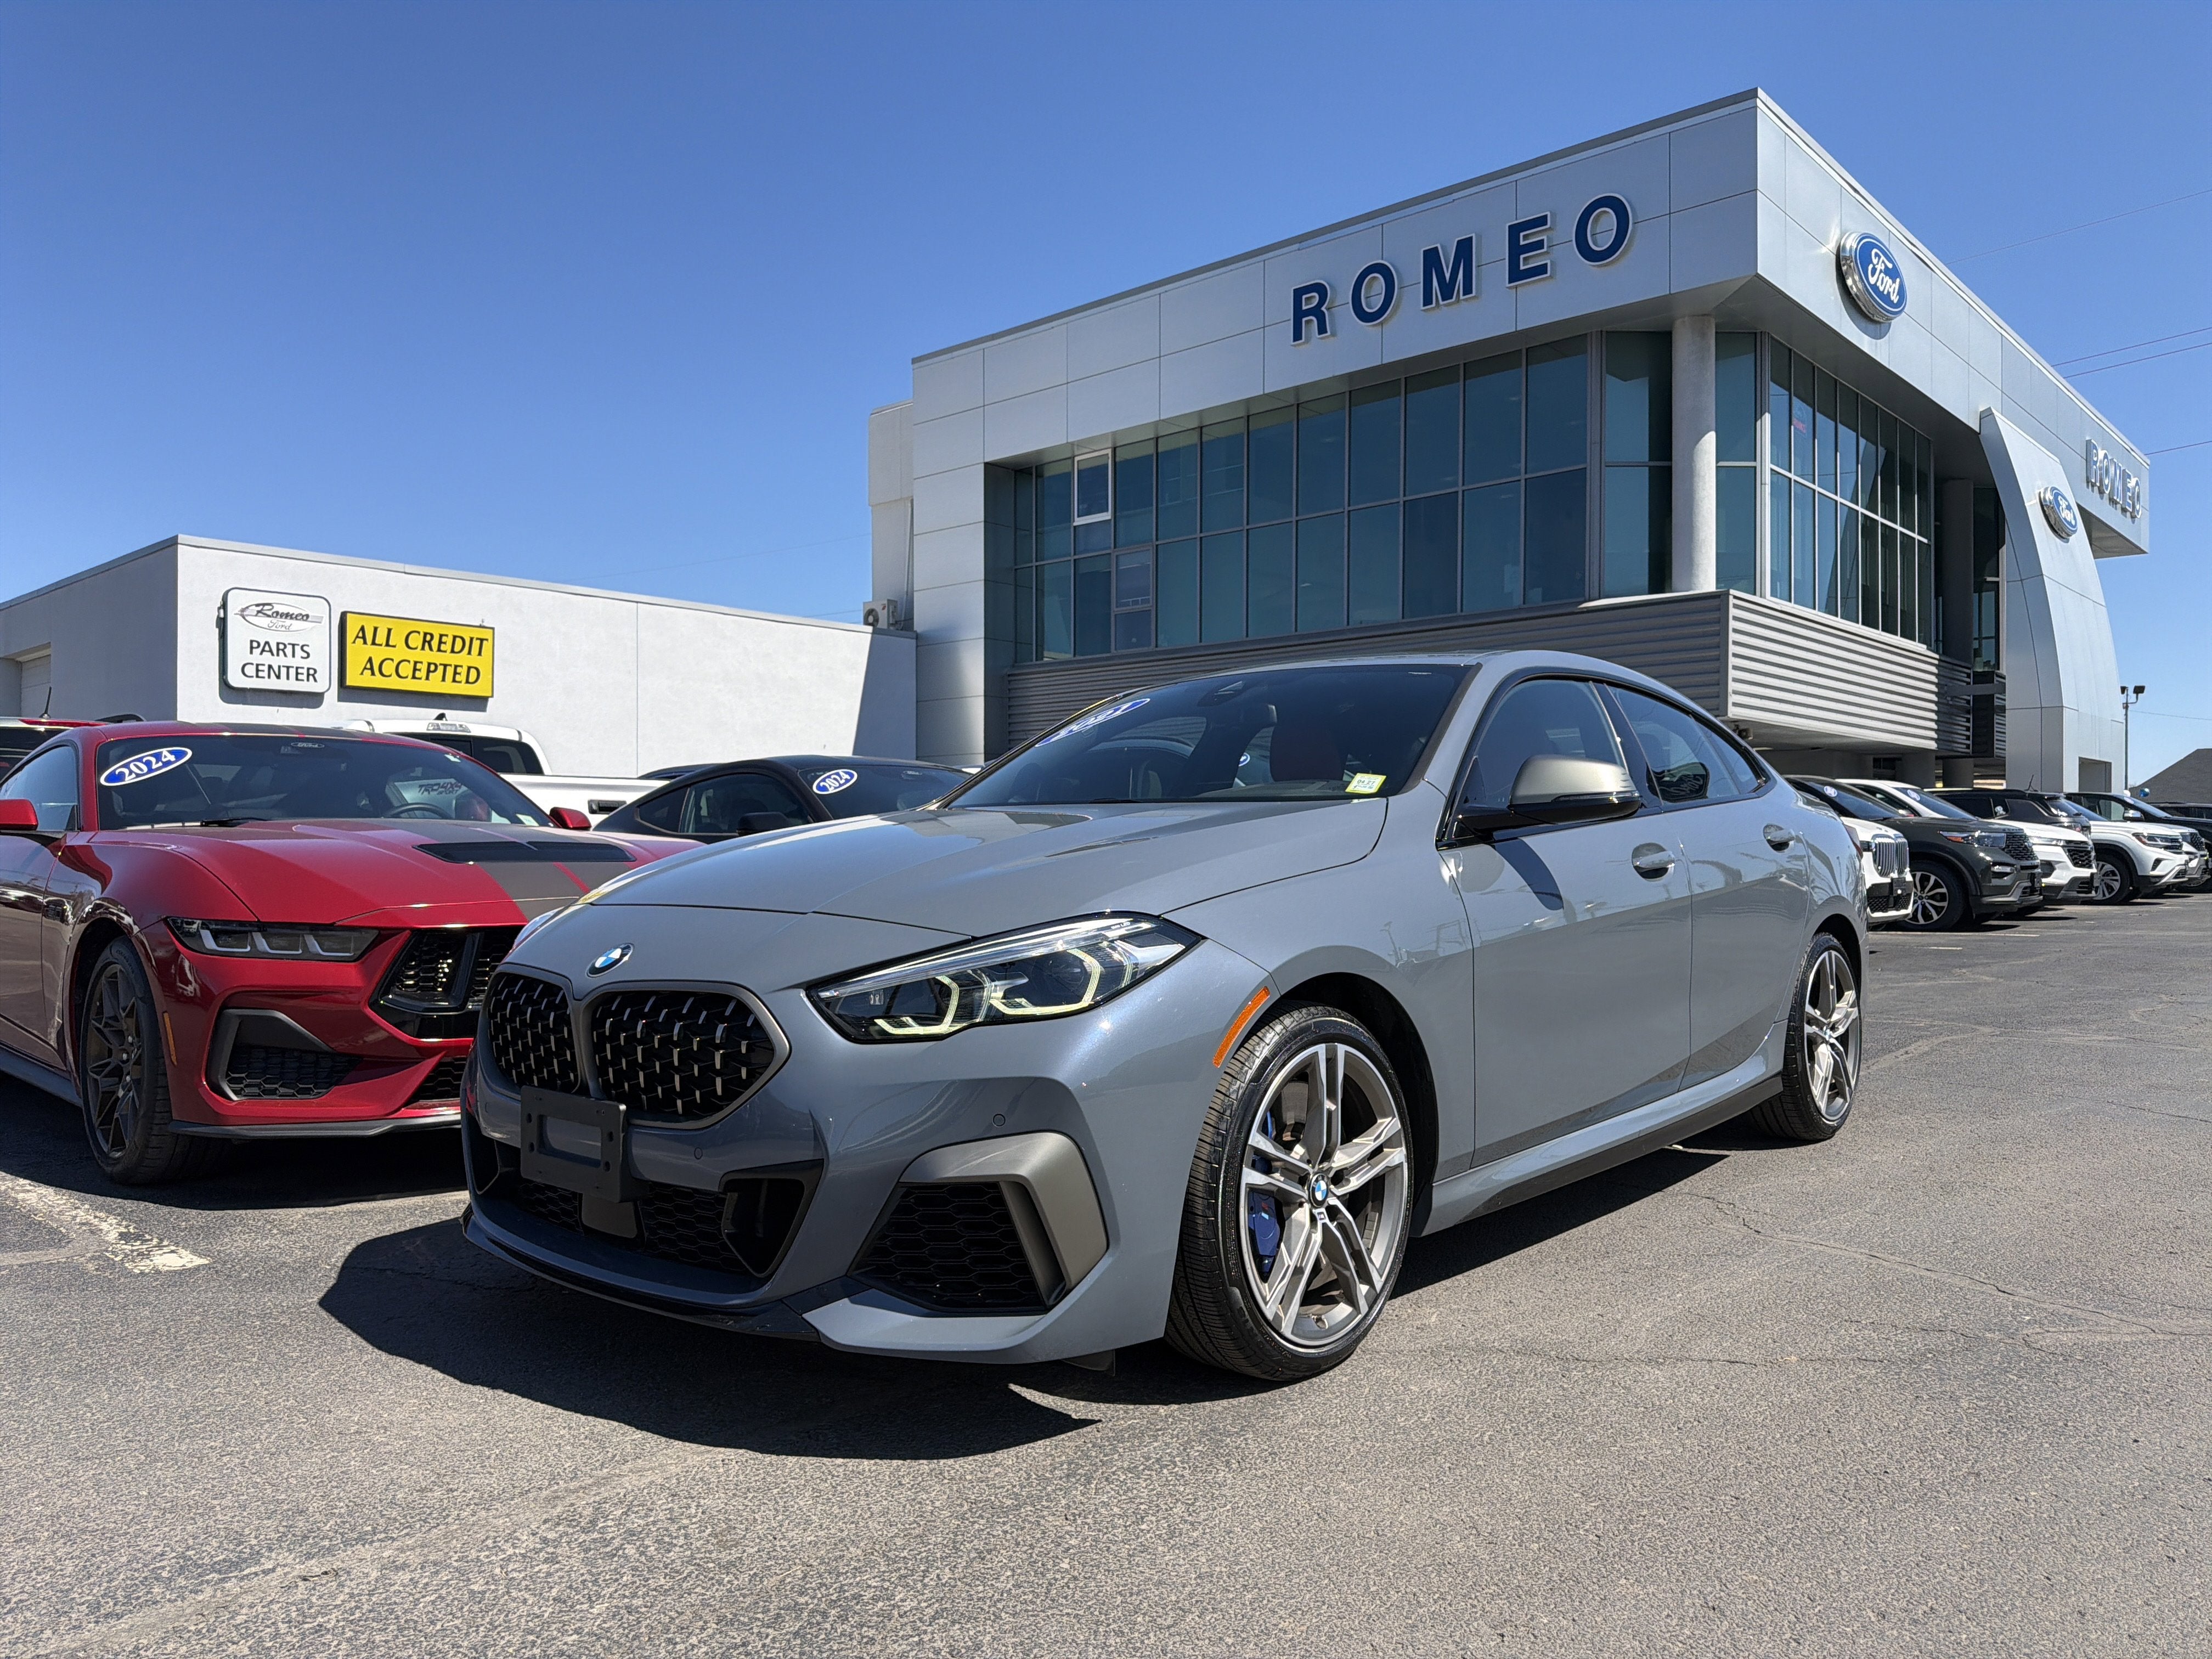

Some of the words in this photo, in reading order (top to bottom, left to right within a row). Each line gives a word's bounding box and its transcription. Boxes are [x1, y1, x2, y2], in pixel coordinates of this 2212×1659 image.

[1291, 193, 1633, 346] ROMEO
[1868, 248, 1900, 303] Ford
[2086, 438, 2142, 518] ROMEO
[255, 603, 309, 621] Romeo
[268, 620, 293, 630] Ford
[249, 639, 311, 659] PARTS
[351, 624, 397, 647] ALL
[404, 630, 489, 657] CREDIT
[240, 662, 318, 684] CENTER
[359, 656, 481, 685] ACCEPTED
[115, 749, 176, 781] 2024
[820, 771, 851, 791] 2024
